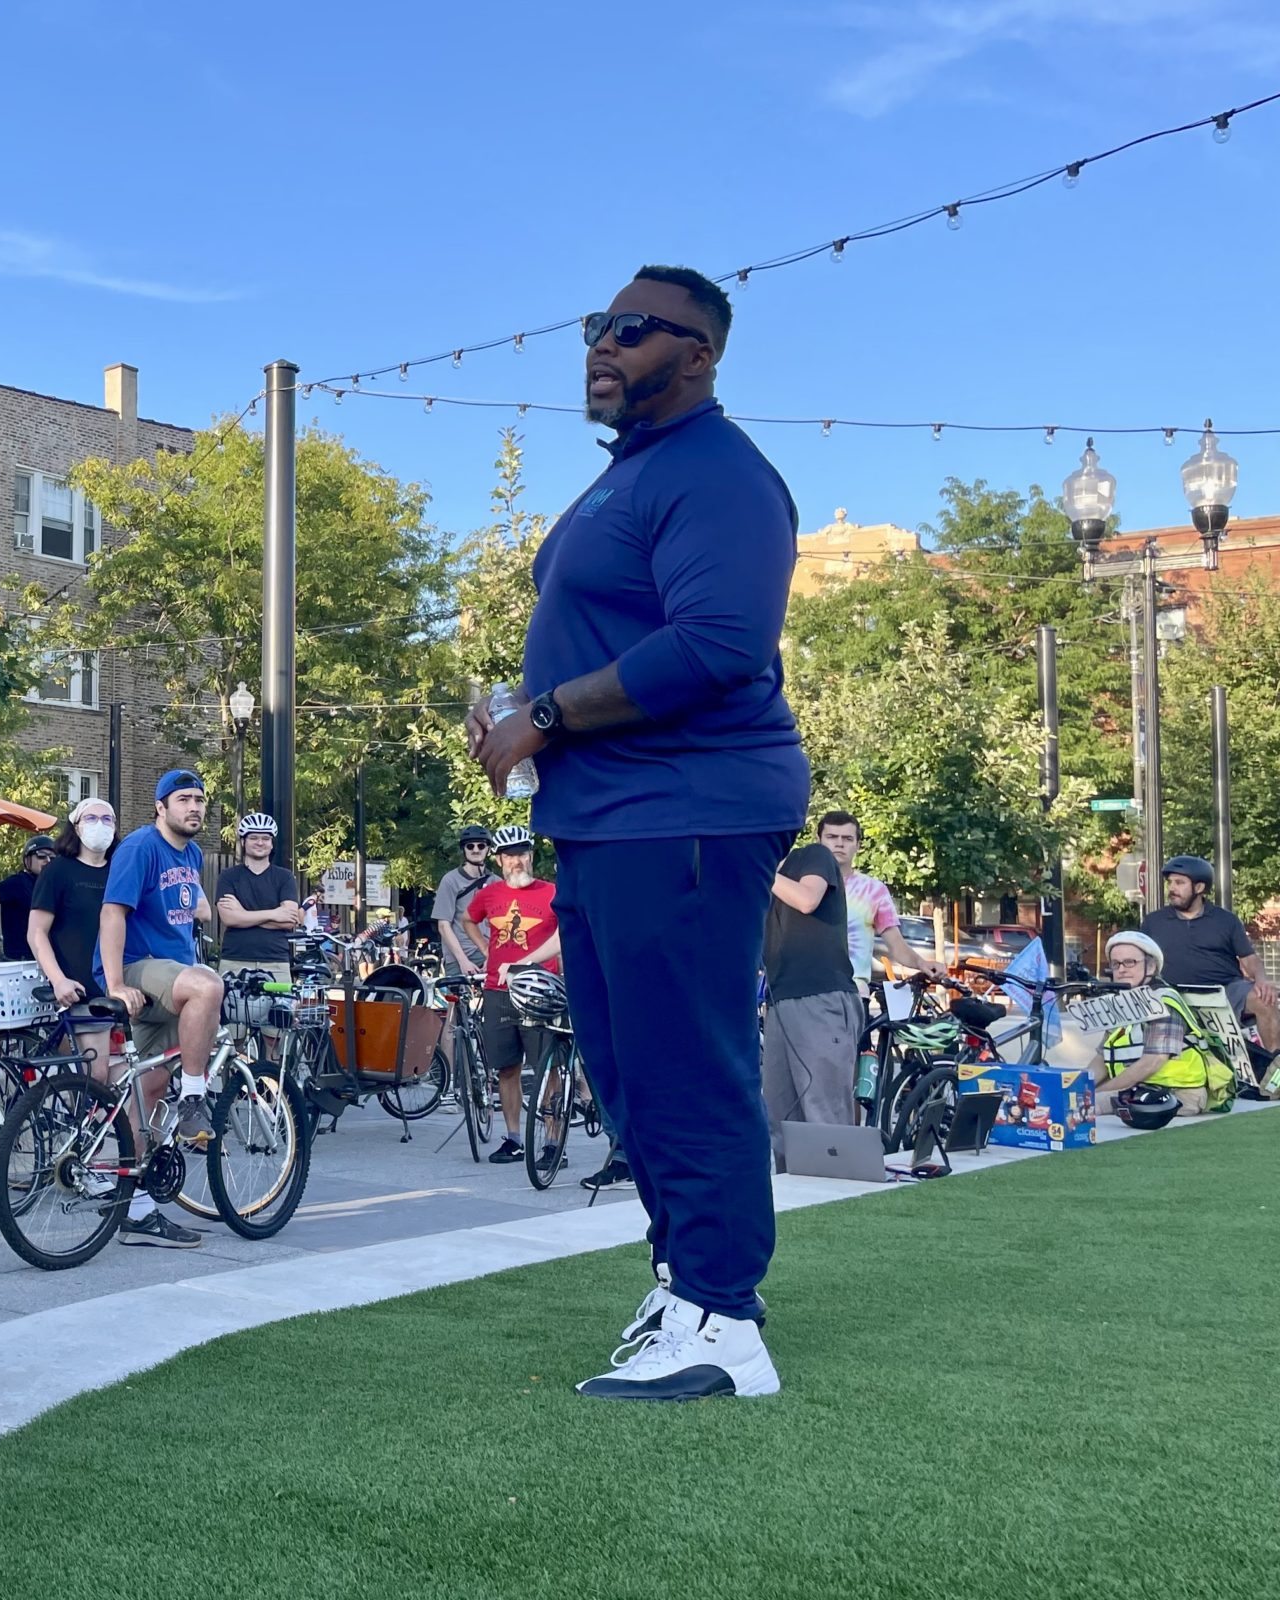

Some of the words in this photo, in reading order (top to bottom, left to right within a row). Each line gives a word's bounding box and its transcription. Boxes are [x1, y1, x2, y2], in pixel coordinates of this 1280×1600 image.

[1068, 999, 1108, 1031] SAFE
[1099, 993, 1132, 1026] BIKE
[1121, 986, 1164, 1020] LANES
[1051, 1125, 1062, 1135] 54
